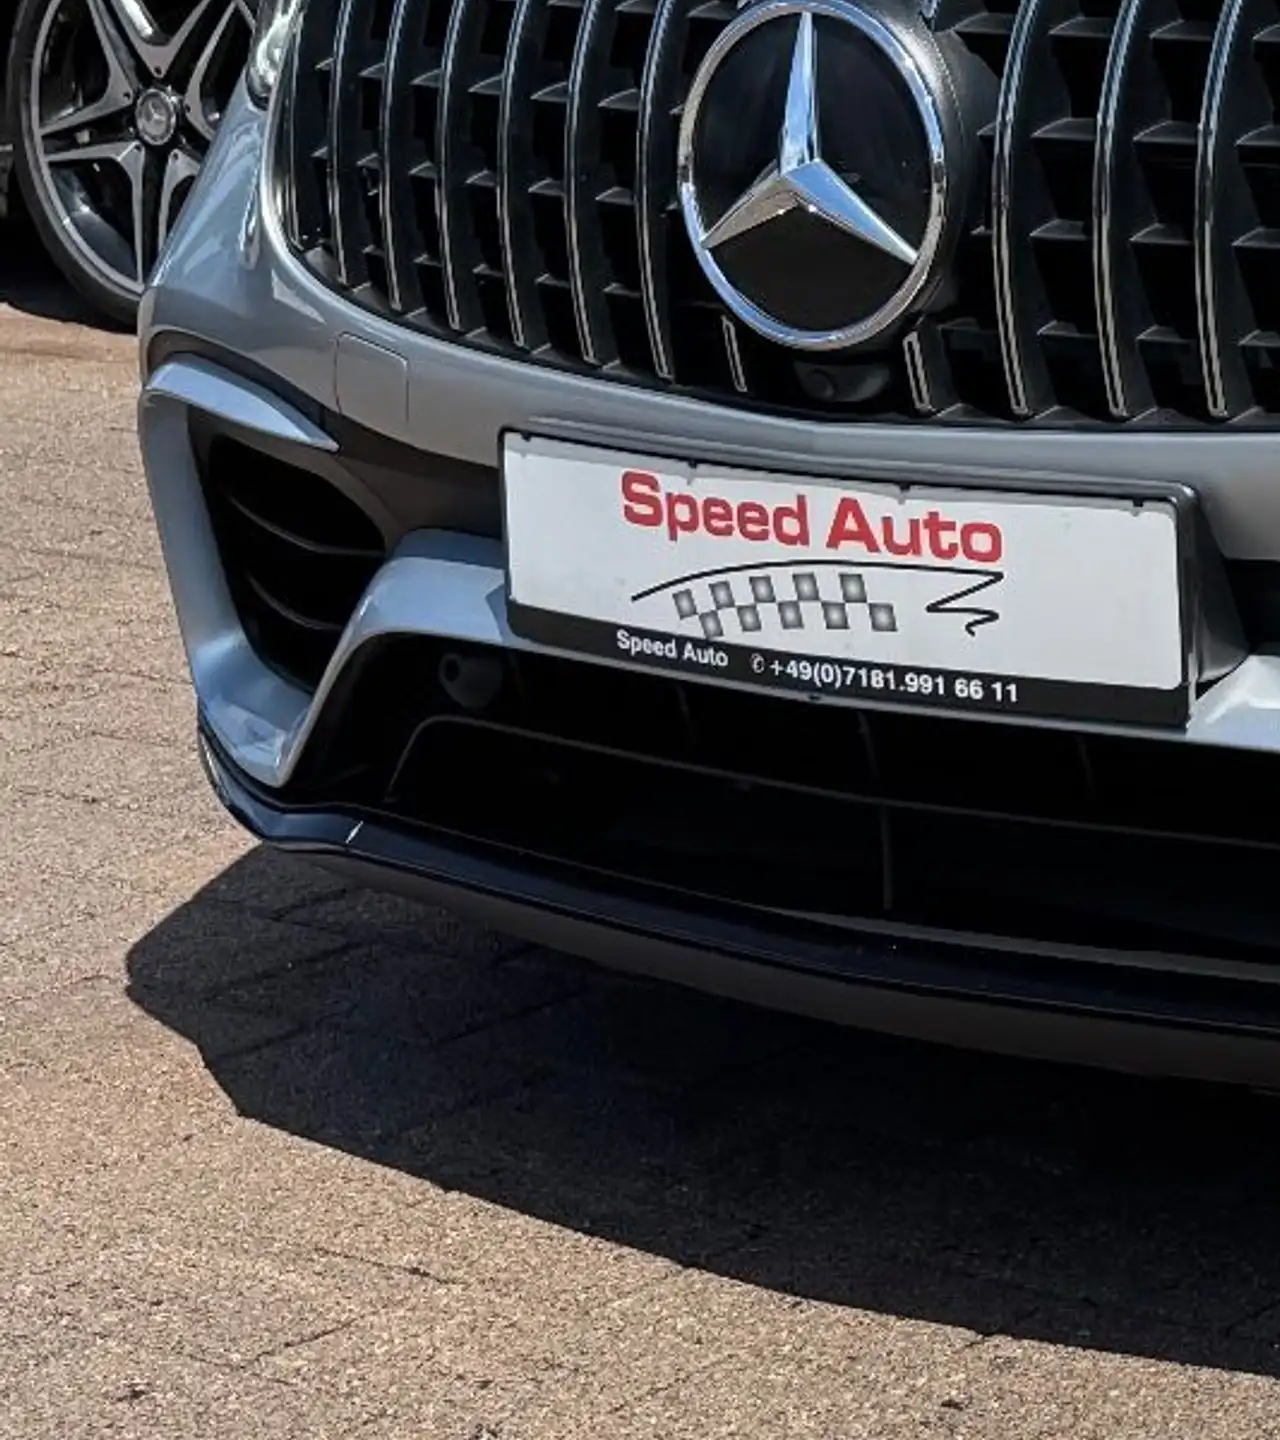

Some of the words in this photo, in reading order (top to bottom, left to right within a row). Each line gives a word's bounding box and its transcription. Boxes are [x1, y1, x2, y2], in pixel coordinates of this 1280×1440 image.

[621, 470, 810, 546] Speed
[826, 496, 1002, 563] Auto
[616, 629, 676, 659] Speed
[682, 637, 729, 667] Auto
[954, 677, 984, 700] 66
[991, 682, 1018, 702] 11
